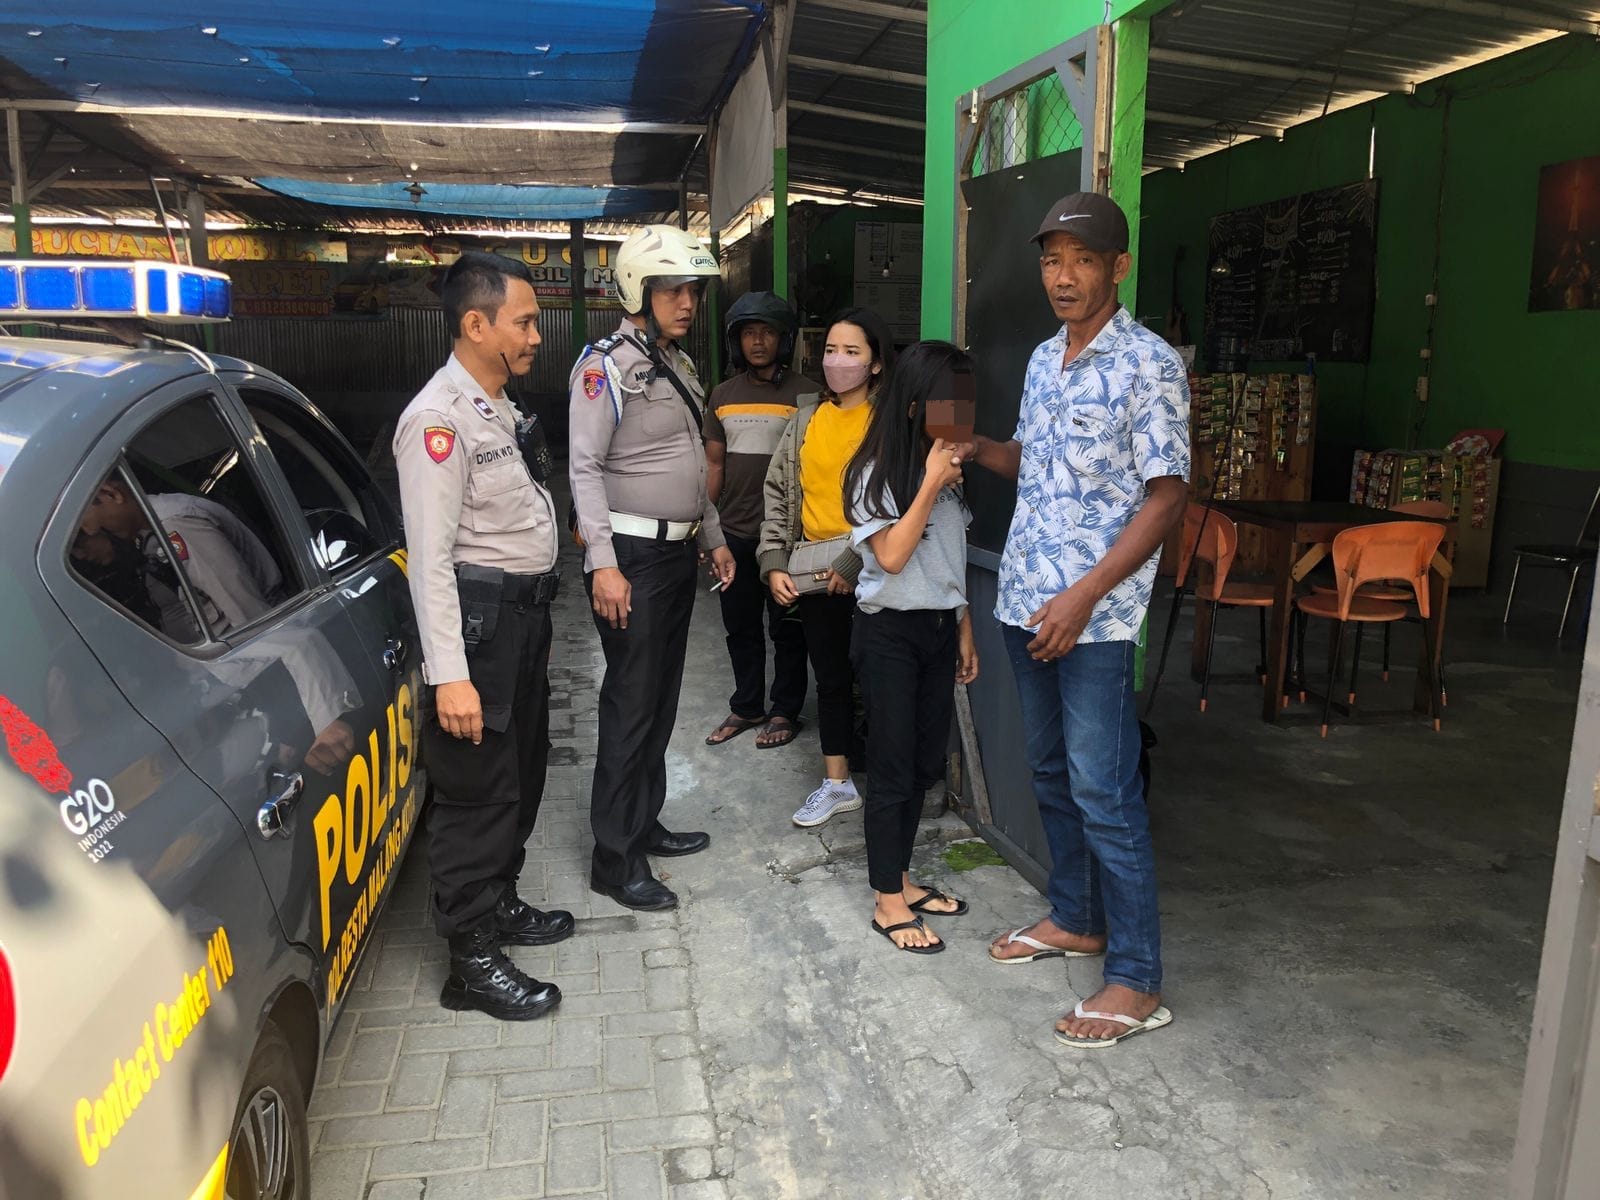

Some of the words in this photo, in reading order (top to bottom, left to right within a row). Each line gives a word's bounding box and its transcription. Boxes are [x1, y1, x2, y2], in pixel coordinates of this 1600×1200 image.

[231, 267, 330, 295] RPET
[531, 267, 569, 283] BIL
[536, 287, 557, 295] BUKA
[557, 287, 573, 295] SET
[634, 370, 649, 382] AGU
[476, 448, 503, 465] DIDIK
[60, 778, 115, 836] G20
[313, 668, 419, 953] POLISI
[77, 810, 128, 852] INDONESIA
[87, 840, 114, 864] 2022
[328, 886, 368, 1006] POLRESTA
[368, 817, 401, 917] MALANG
[75, 1021, 160, 1168] Contact
[154, 965, 212, 1063] Center
[207, 925, 235, 991] 110
